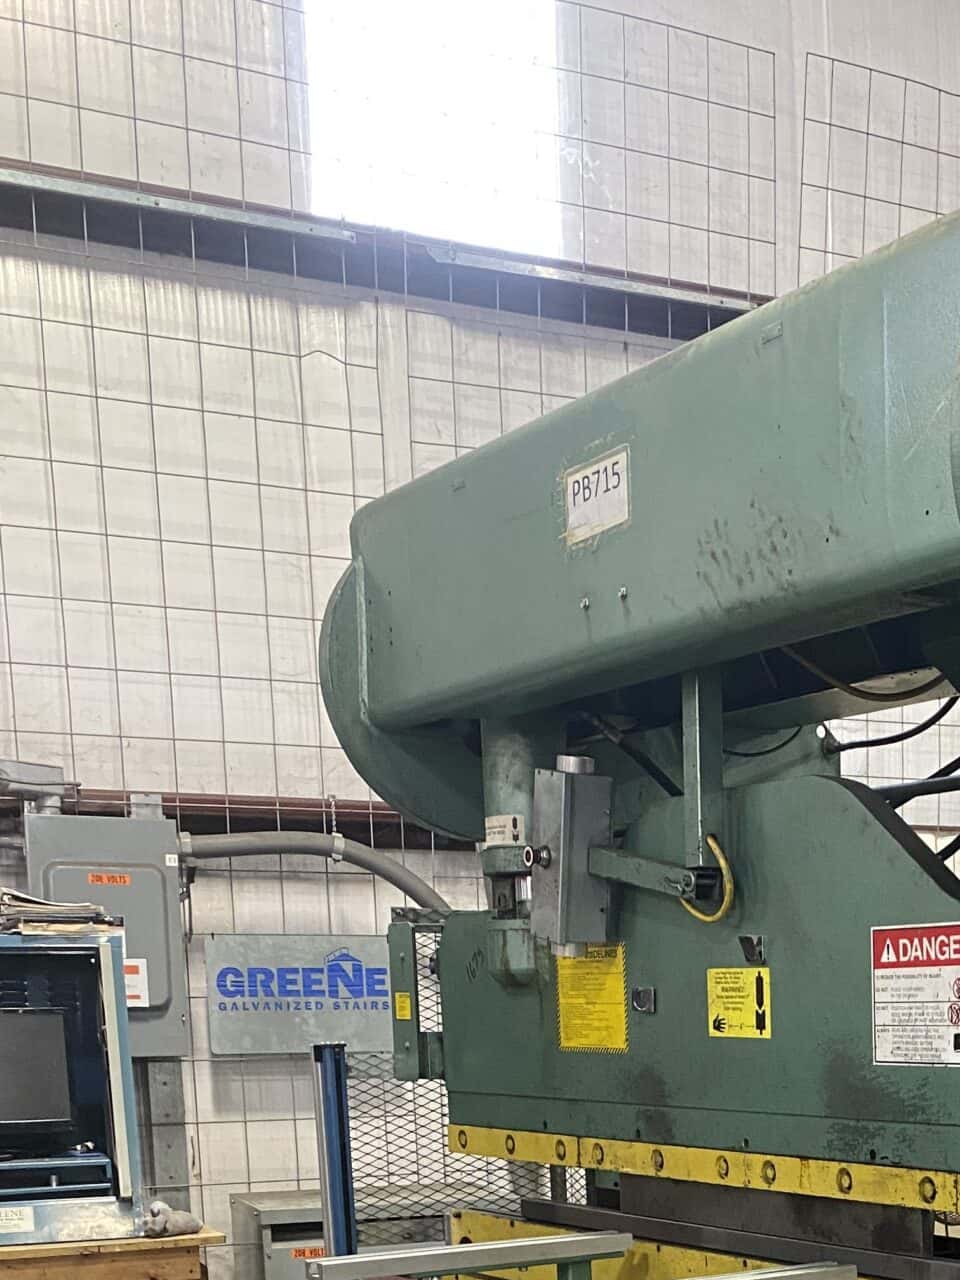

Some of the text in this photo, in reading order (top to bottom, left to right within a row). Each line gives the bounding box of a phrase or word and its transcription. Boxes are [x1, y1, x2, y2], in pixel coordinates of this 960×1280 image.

[572, 461, 621, 507] PB715
[216, 963, 390, 999] GREENE
[218, 1001, 390, 1011] GALVANIZED STAIRS
